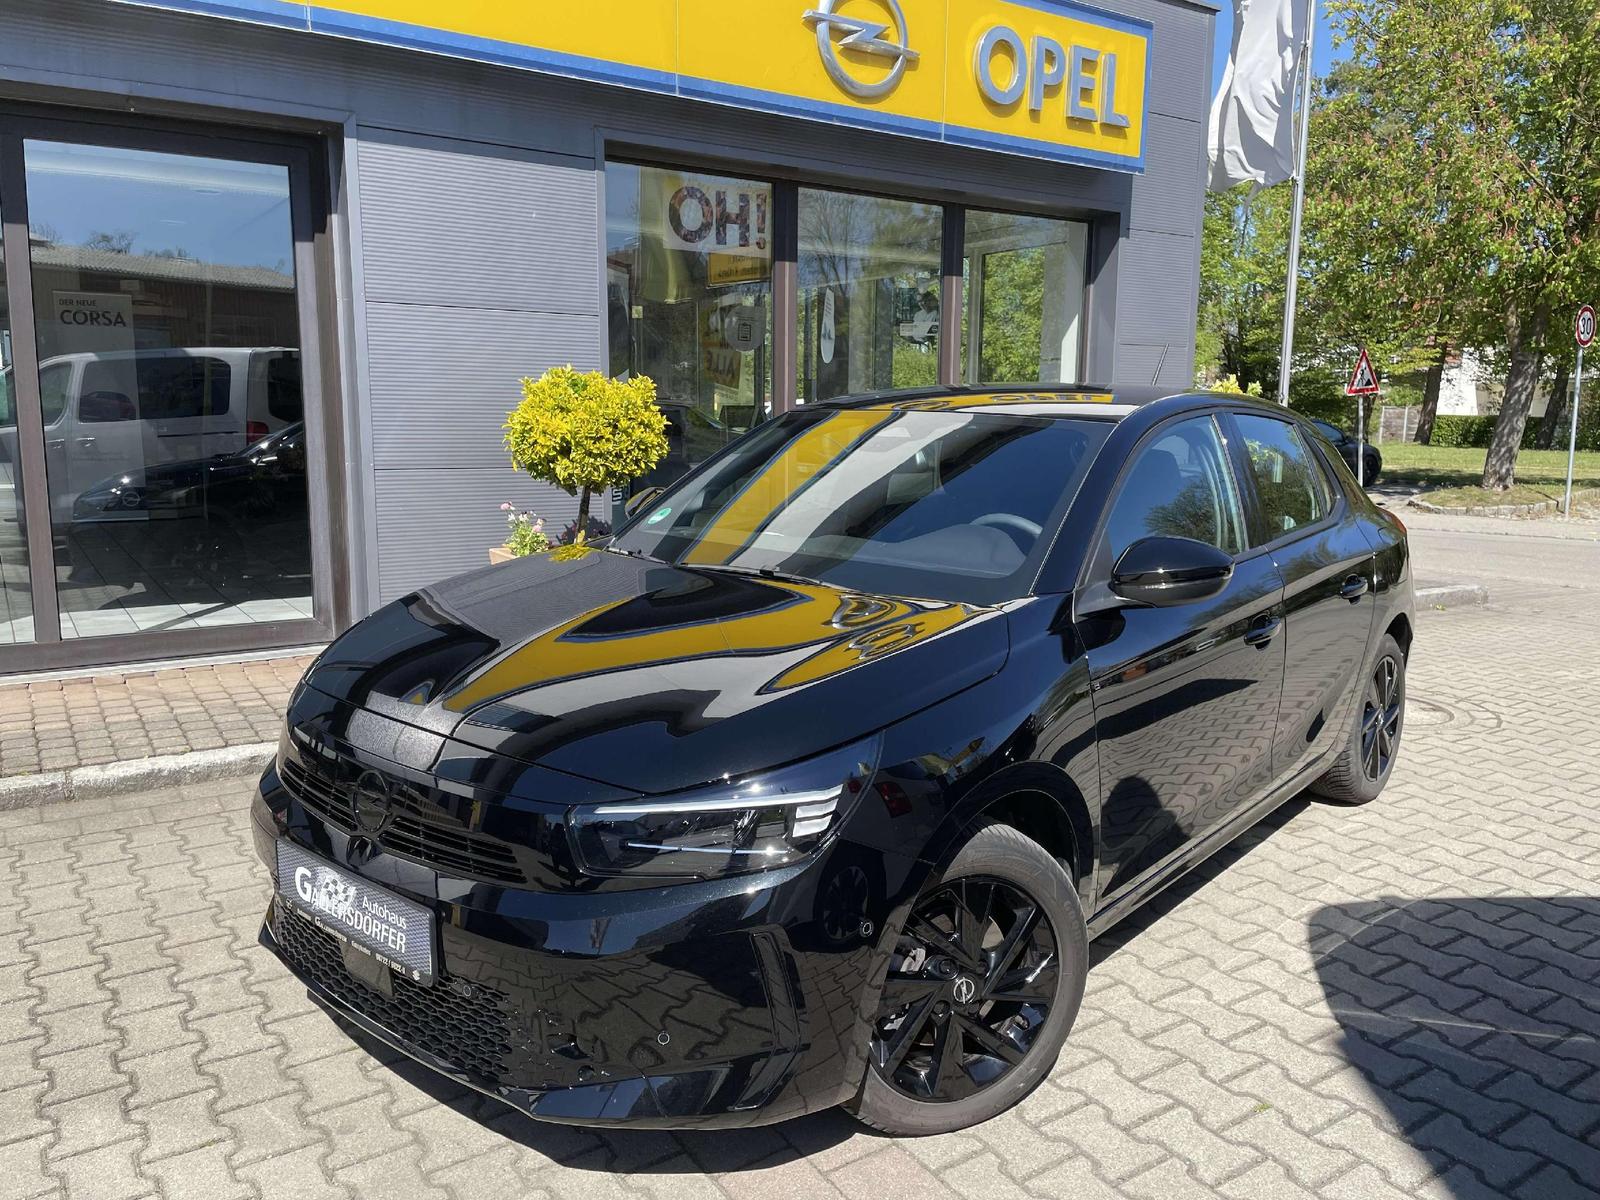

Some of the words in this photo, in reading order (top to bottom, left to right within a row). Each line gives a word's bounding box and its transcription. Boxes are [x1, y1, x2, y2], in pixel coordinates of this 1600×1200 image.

[973, 25, 1130, 128] OPEL
[669, 186, 767, 250] OH!
[59, 298, 74, 306] DER
[76, 299, 97, 307] NEUE
[60, 309, 126, 327] CORSA
[1581, 317, 1592, 335] 30
[362, 896, 407, 929] Autohaus
